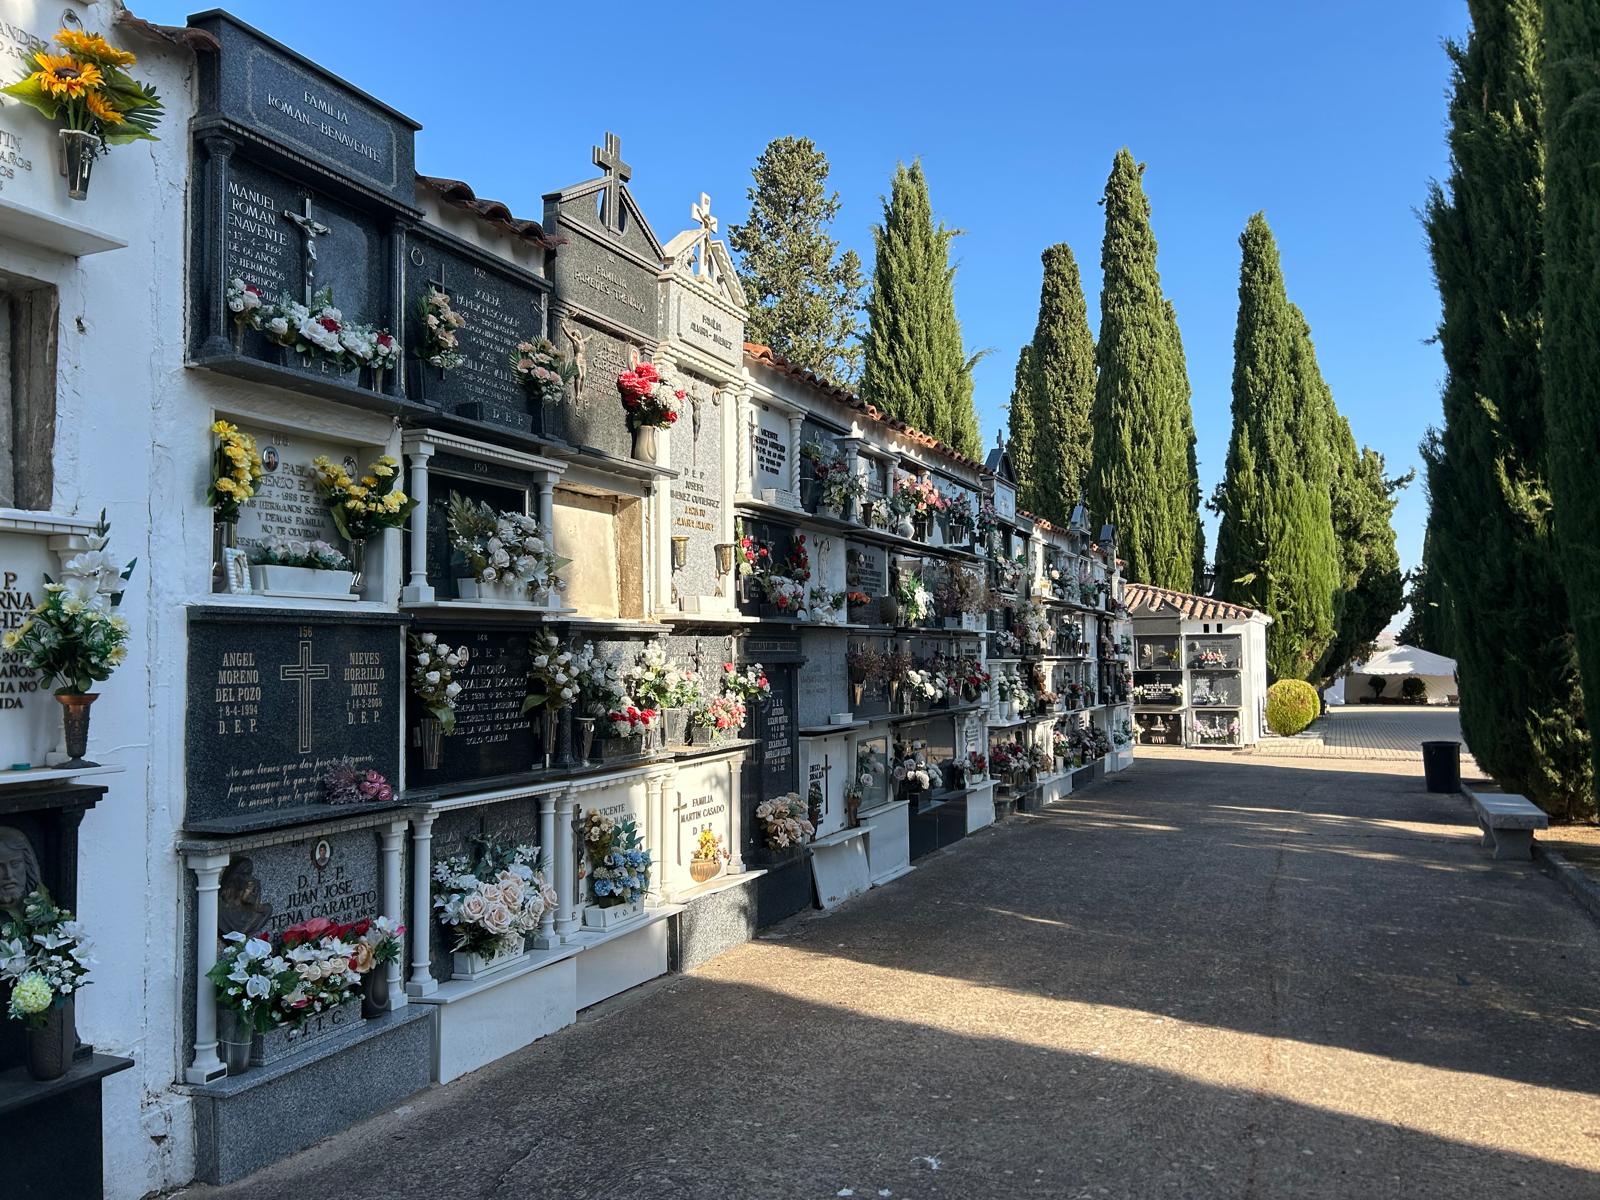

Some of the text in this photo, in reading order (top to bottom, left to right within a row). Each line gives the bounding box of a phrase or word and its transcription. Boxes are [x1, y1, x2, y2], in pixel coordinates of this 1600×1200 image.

[304, 90, 349, 125] FAMILIA
[267, 93, 381, 163] ROMAN BENAVENTE
[228, 181, 279, 213] MANUEL
[232, 197, 276, 226] ROMAN
[228, 212, 288, 247] ENAVENTE
[239, 257, 286, 281] HERMANOS
[595, 265, 628, 290] FAMILIA
[236, 268, 278, 290] SOBRINOS
[573, 270, 611, 296] PAREDES
[702, 314, 722, 332] FAMILIA
[473, 463, 488, 474] 150
[261, 523, 273, 534] NO
[295, 516, 326, 529] FAMILIA
[222, 652, 255, 667] ANGEL
[349, 651, 380, 665] NIEVES
[218, 669, 259, 685] MORENO
[343, 667, 385, 681] HORRILLO
[18, 682, 38, 693] NO
[350, 682, 378, 697] MONJE
[458, 679, 492, 690] NZALEZ
[215, 686, 262, 703] DEL POZO
[692, 794, 714, 807] FAMILIA
[599, 803, 626, 816] VICENTE
[680, 804, 725, 823] MARTIN CASADO
[286, 880, 353, 909] JUAN JOSE
[270, 890, 377, 929] TENA CARAPETO
